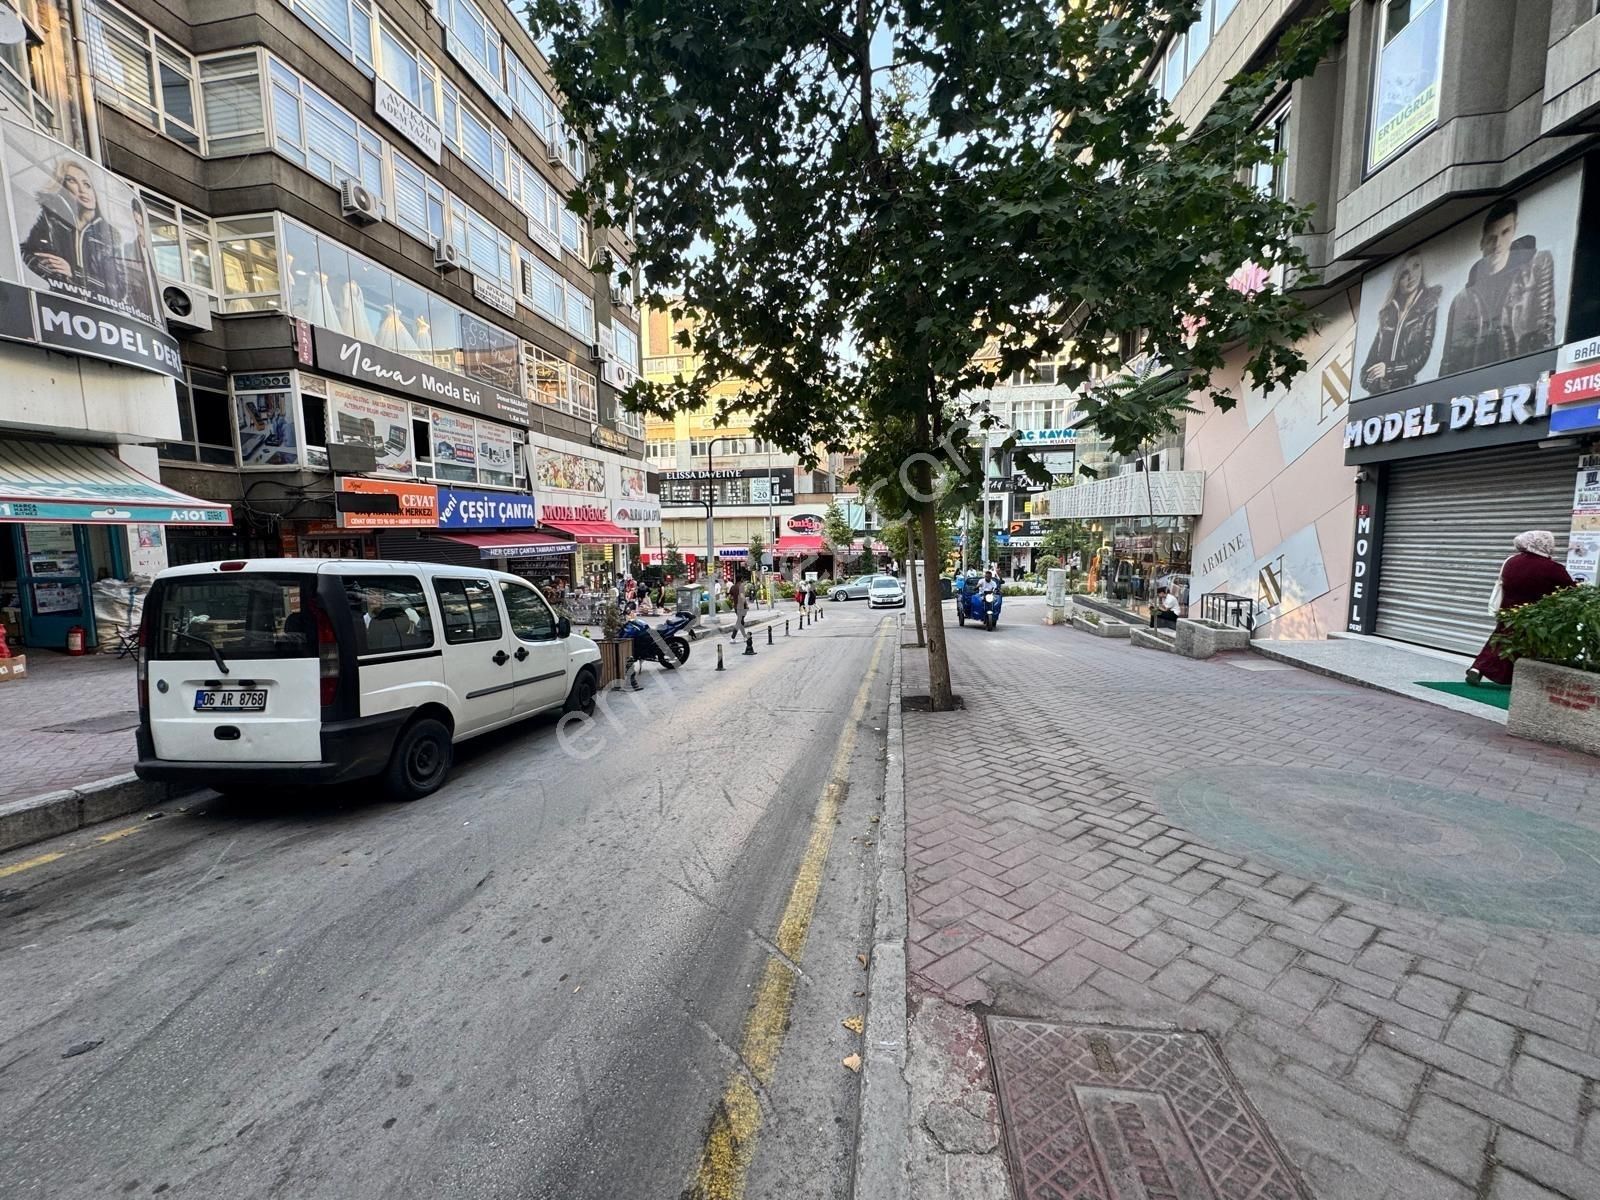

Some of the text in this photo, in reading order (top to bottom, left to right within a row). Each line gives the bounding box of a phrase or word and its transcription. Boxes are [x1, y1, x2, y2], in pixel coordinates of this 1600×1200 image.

[380, 97, 407, 126] ADEM
[387, 93, 431, 133] AVUKAT
[41, 306, 149, 356] MODEL
[421, 373, 480, 405] Moda Evi
[1344, 403, 1440, 449] MODEL
[402, 494, 435, 508] CEVAT
[459, 496, 534, 523] ÇEŞİT ÇANTA
[490, 548, 503, 556] HER
[503, 547, 518, 556] ÇEŞİT
[519, 546, 535, 555] ÇANTA
[1203, 534, 1245, 577] ARMİNE
[761, 565, 769, 574] P
[1352, 517, 1371, 622] MODEL
[203, 692, 264, 706] 06 AR 8768
